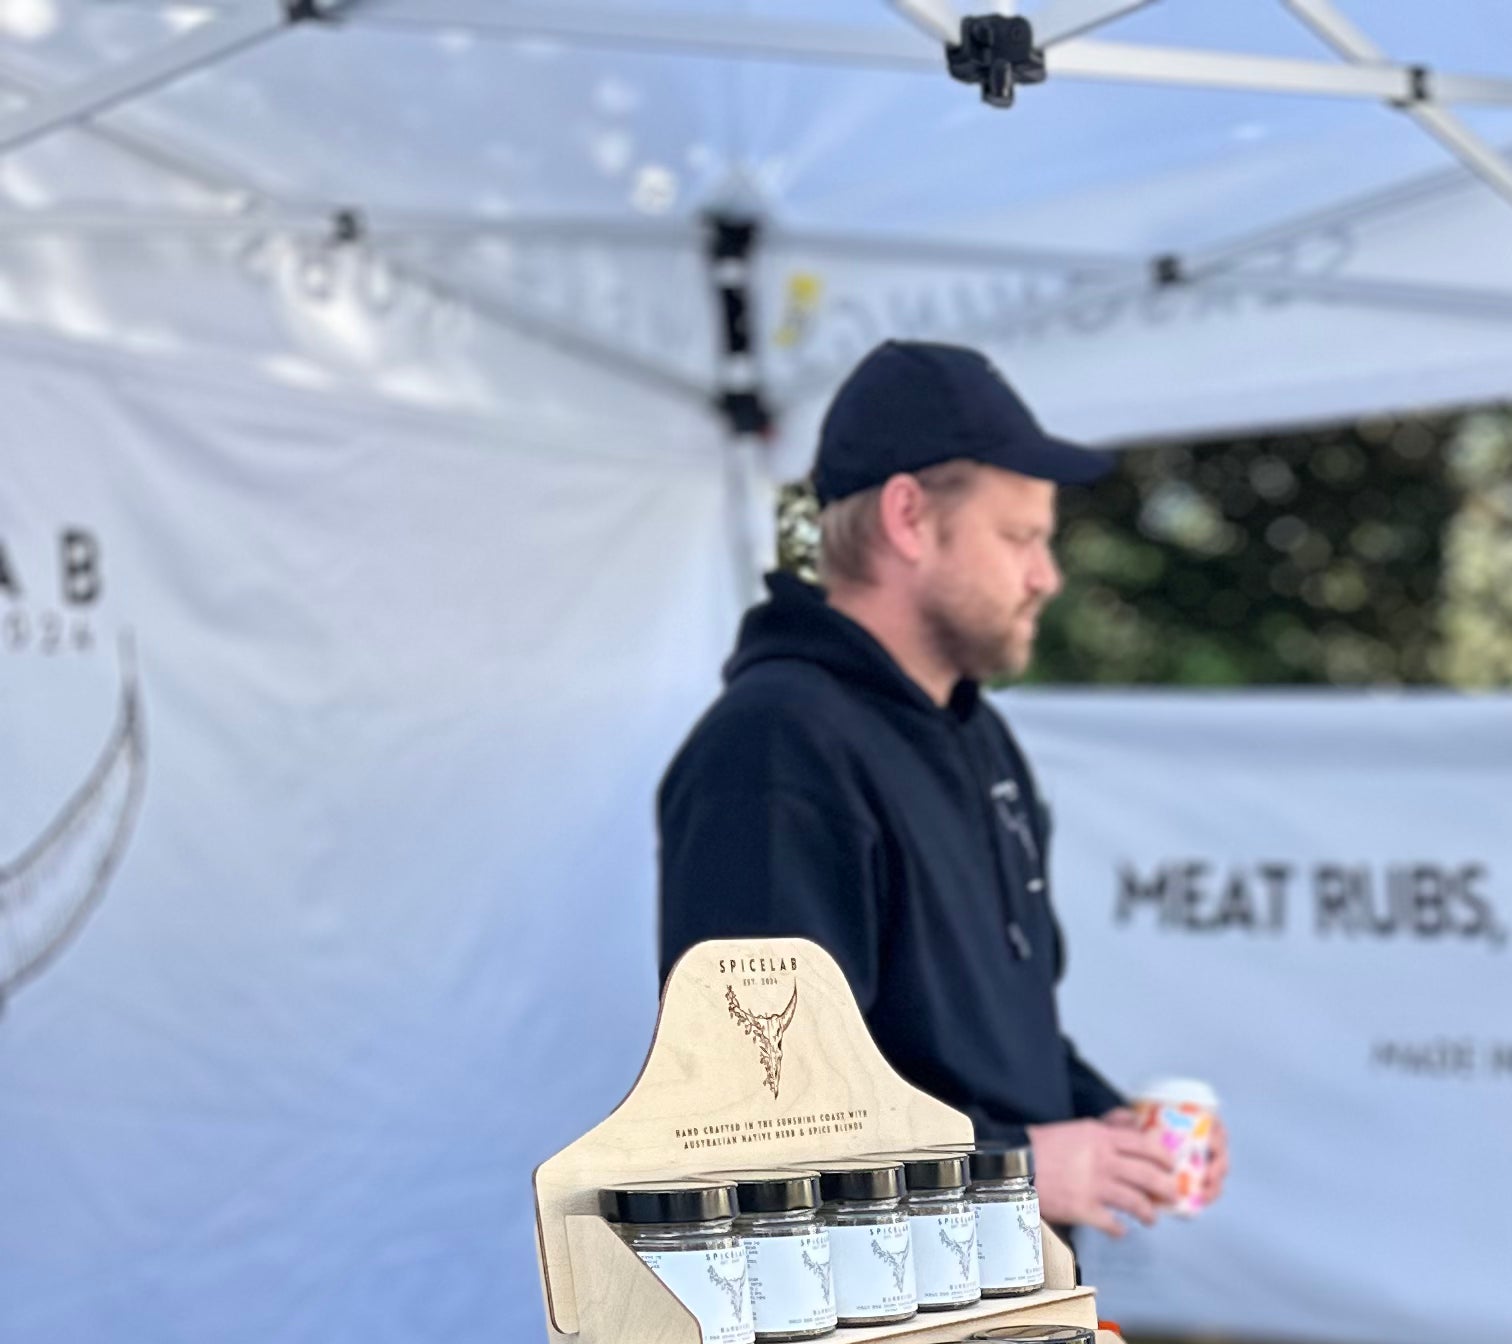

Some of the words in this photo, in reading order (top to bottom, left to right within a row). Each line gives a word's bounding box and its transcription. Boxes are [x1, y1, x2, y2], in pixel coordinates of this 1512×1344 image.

[1112, 858, 1293, 934] MEAT
[1312, 860, 1506, 950] RUBS,
[719, 957, 797, 973] SPICELAB
[675, 1128, 699, 1139] HAND
[704, 1122, 741, 1135] CRAFTED
[745, 1121, 754, 1130] IN
[758, 1119, 773, 1129] THE
[777, 1114, 817, 1127] SUNSHINE
[820, 1111, 845, 1122] COAST
[849, 1109, 868, 1119] WITH
[684, 1135, 738, 1150] AUSTRALIAN
[742, 1131, 772, 1143] NATIVE
[775, 1129, 796, 1139] HERB
[808, 1125, 831, 1136] SPICE
[835, 1121, 864, 1133] BLENDS
